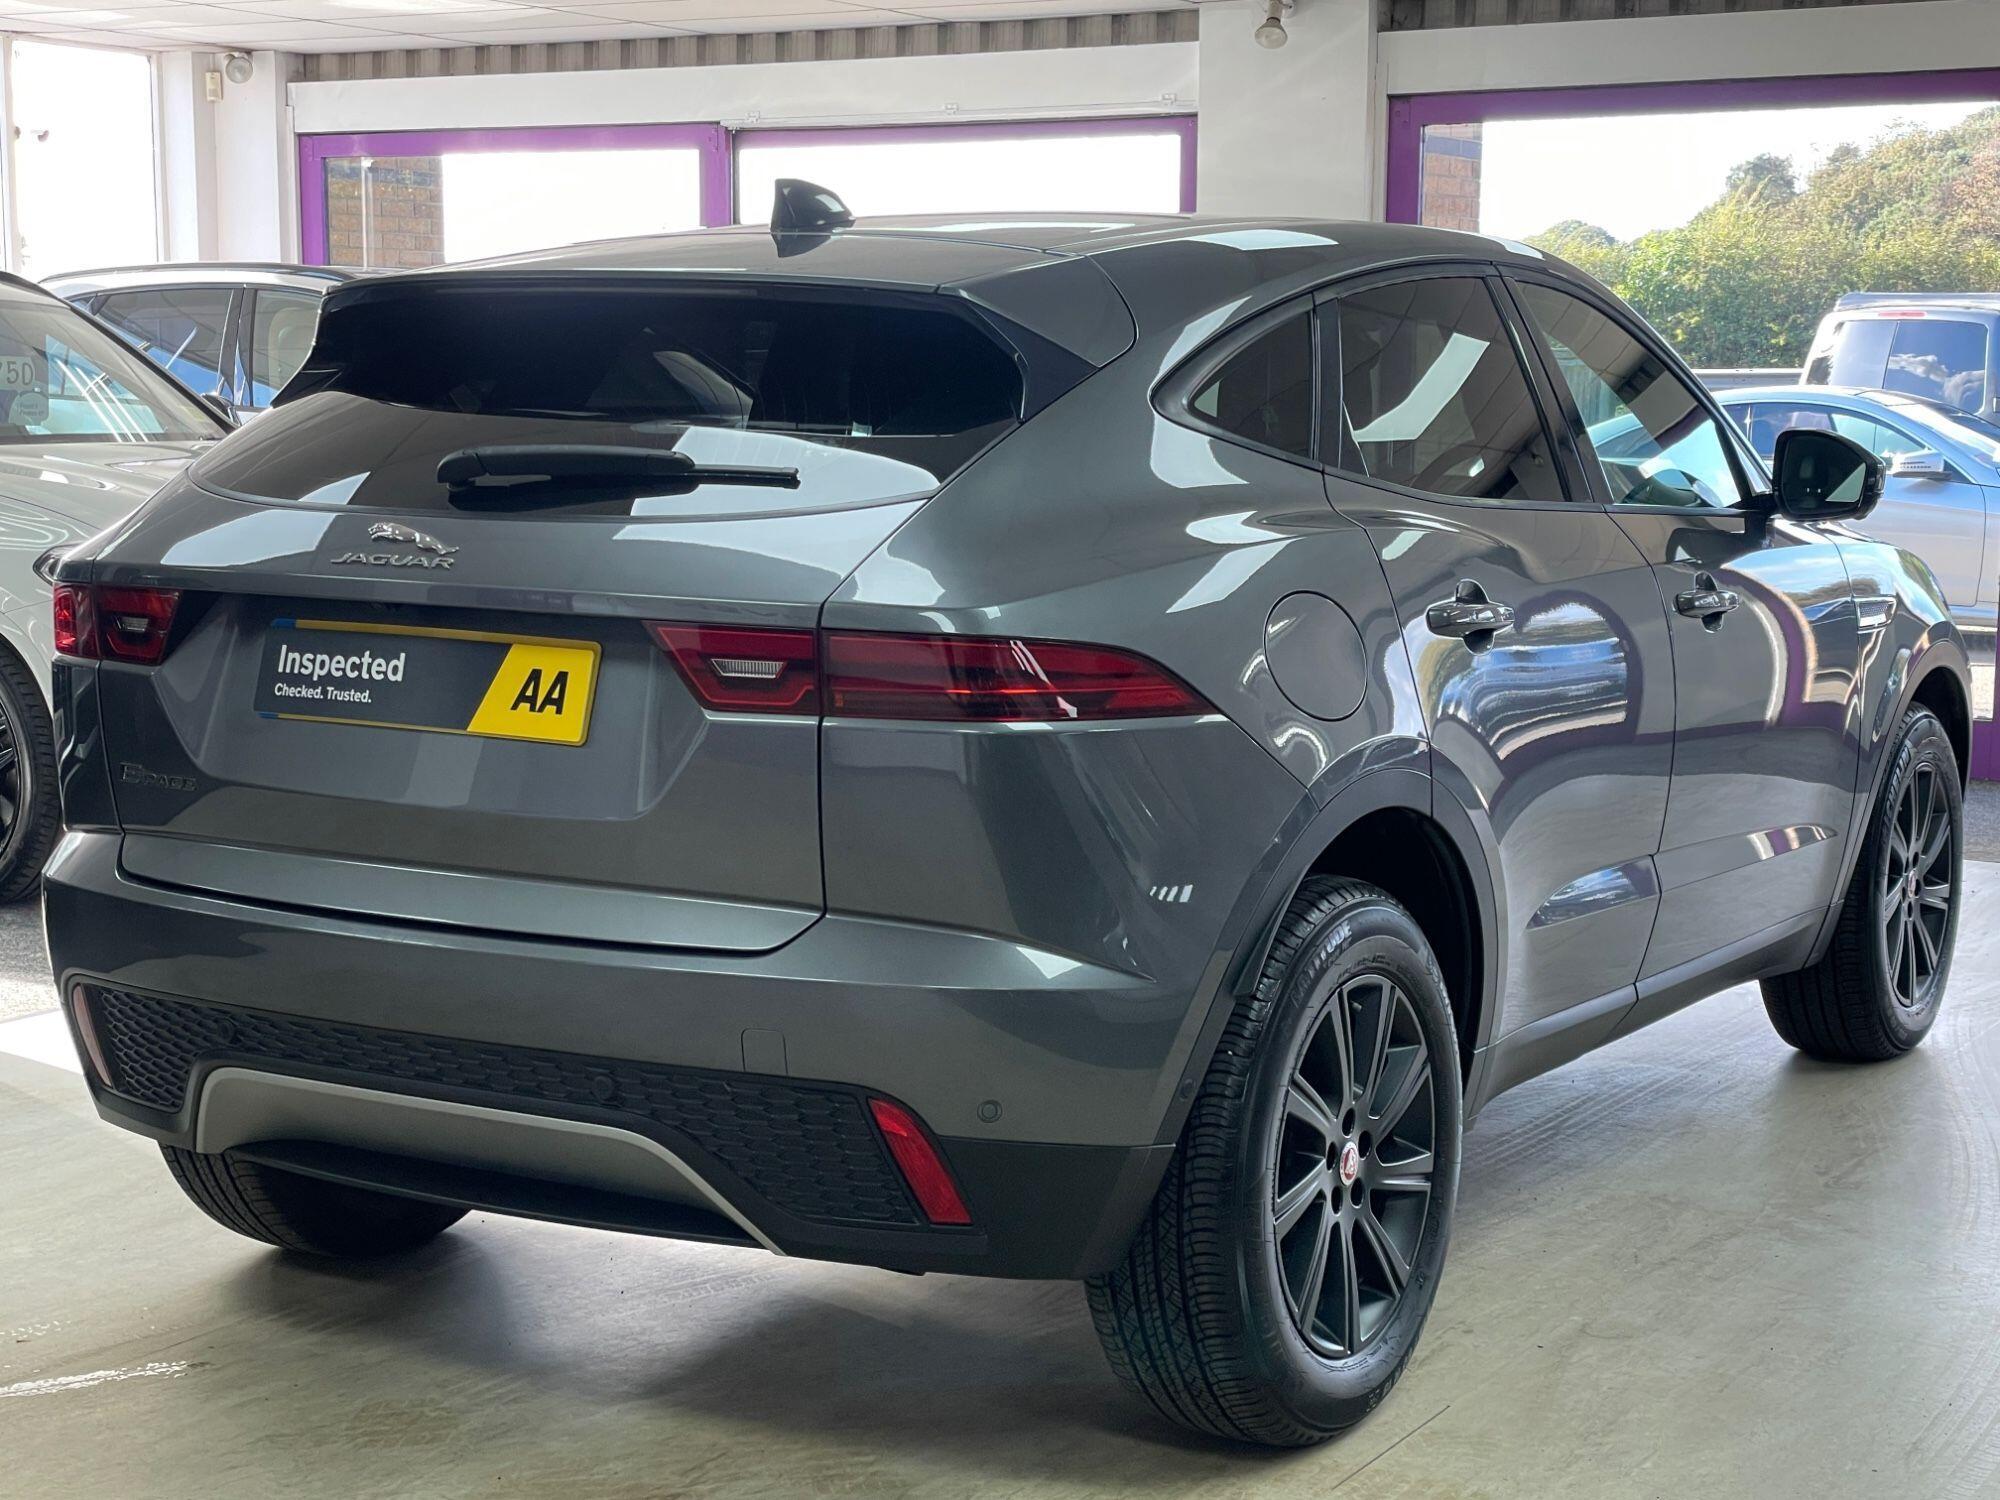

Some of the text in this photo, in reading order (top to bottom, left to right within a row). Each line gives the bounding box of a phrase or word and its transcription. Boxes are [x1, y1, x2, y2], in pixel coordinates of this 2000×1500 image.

[0, 361, 34, 386] 50
[330, 552, 455, 570] JAGUAR
[277, 644, 406, 682] Inspected
[274, 682, 372, 704] Checked. Trusted.
[510, 668, 570, 715] AA
